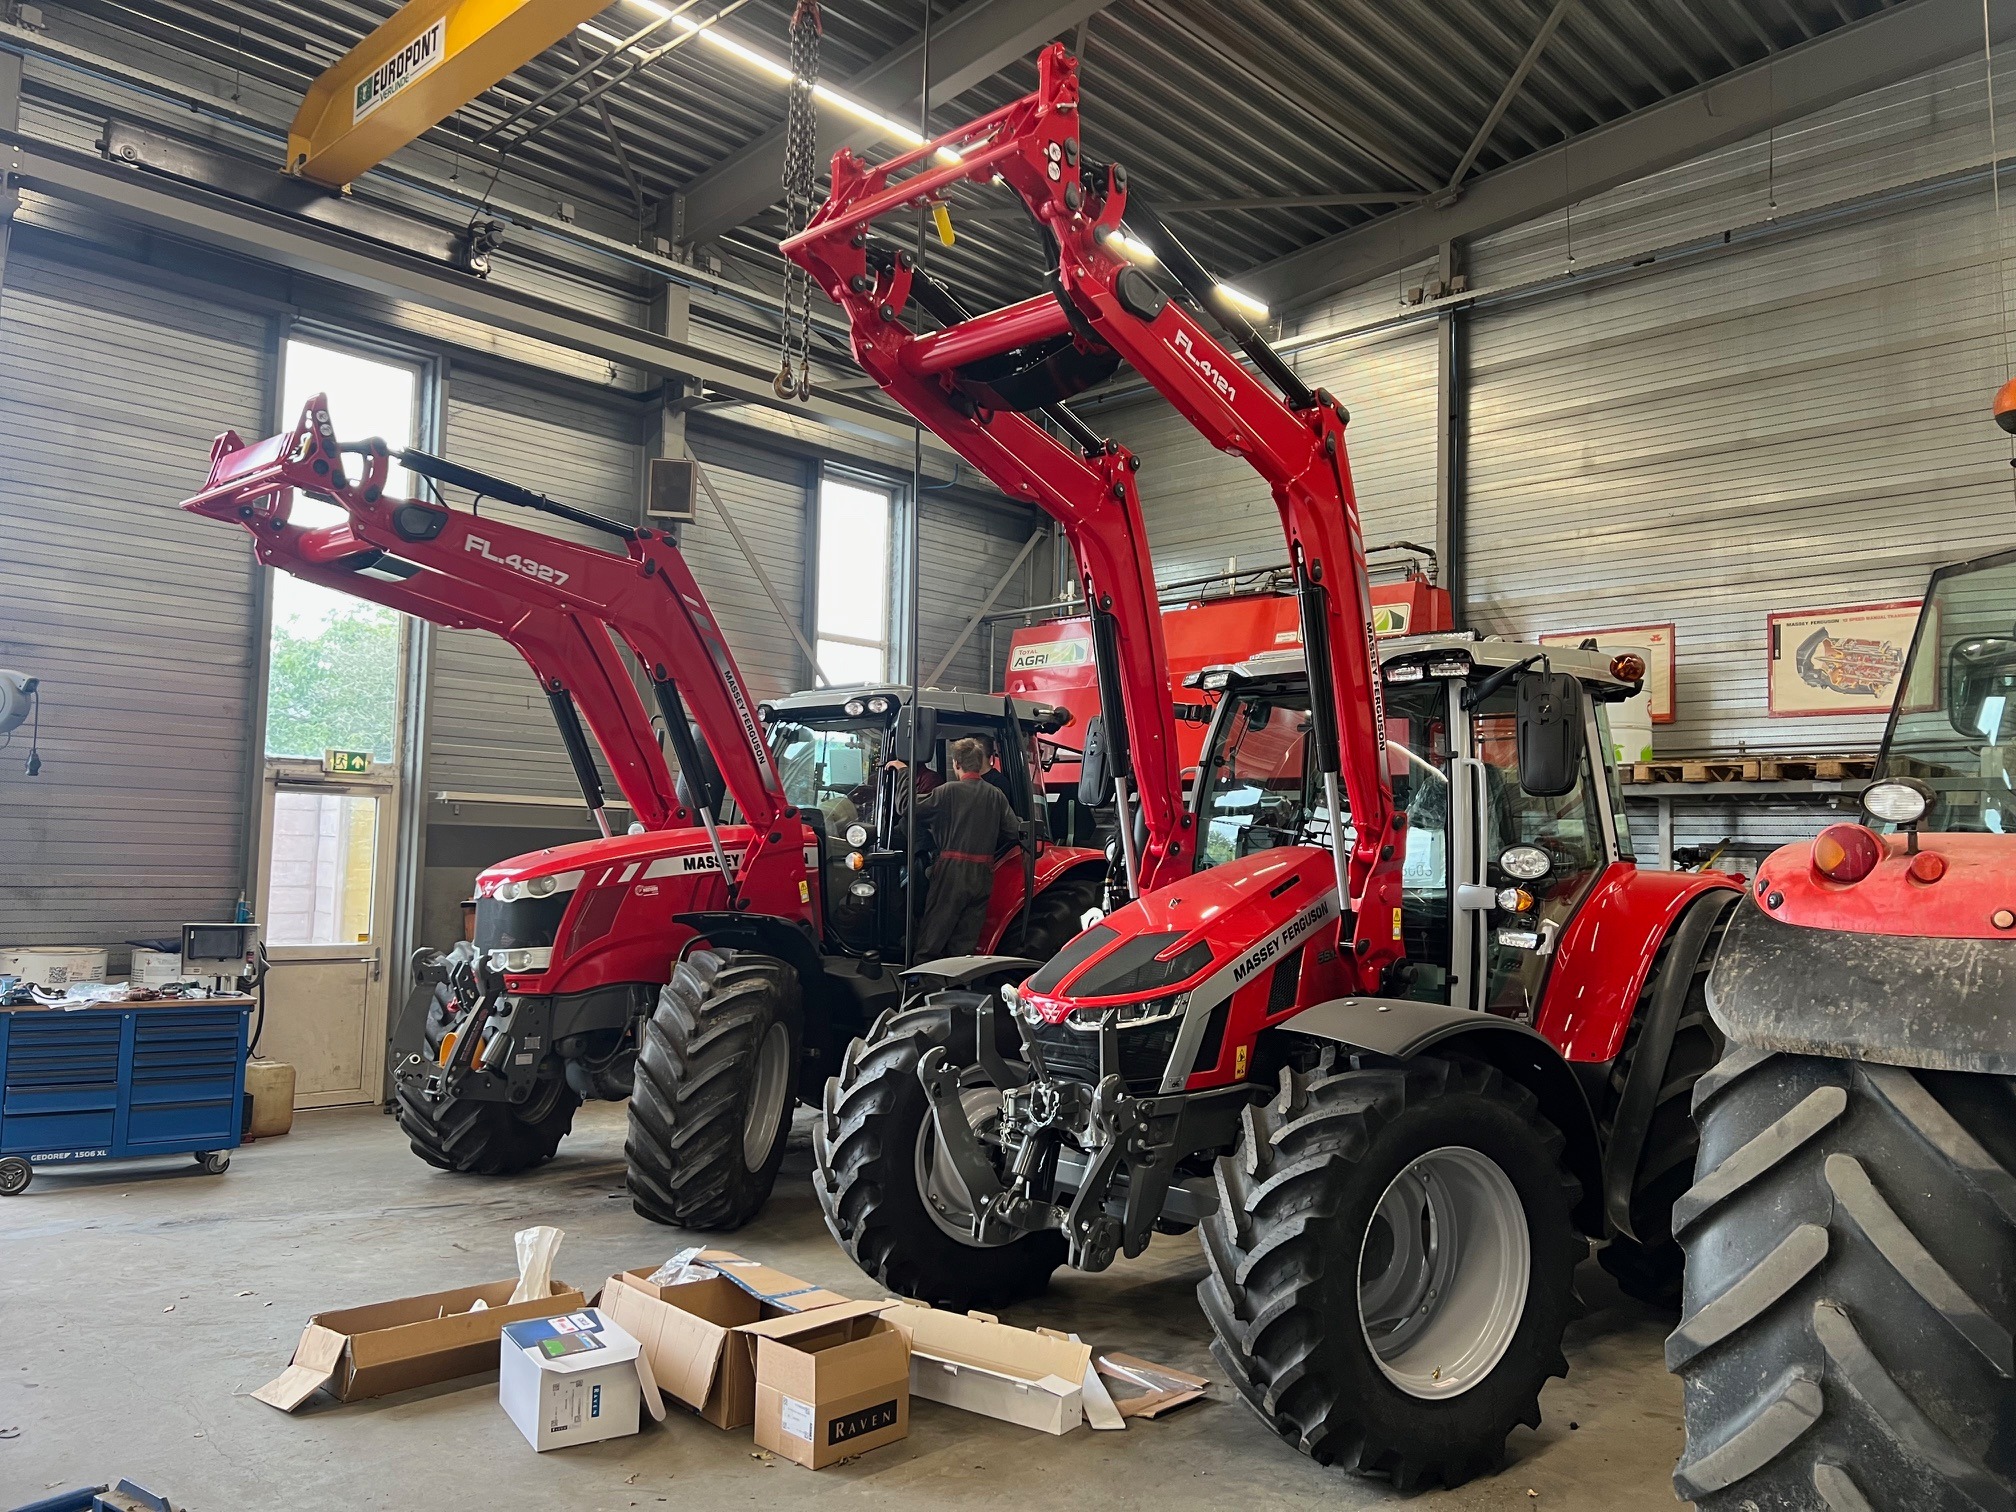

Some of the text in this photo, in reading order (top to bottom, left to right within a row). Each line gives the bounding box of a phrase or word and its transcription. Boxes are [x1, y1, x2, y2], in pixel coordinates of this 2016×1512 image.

[373, 25, 439, 96] EUROPONT
[380, 73, 410, 101] VERLINDE
[1174, 328, 1236, 402] FL.4121
[464, 533, 570, 586] FL.4327
[1014, 654, 1049, 667] AGRI
[1366, 621, 1386, 751] MASSEY FERGUSON
[724, 670, 766, 765] MASSEY FERGUSON
[1233, 901, 1329, 982] MASSEY FERGUSON
[74, 1151, 96, 1159] 1506
[835, 1410, 891, 1439] RAVEN
